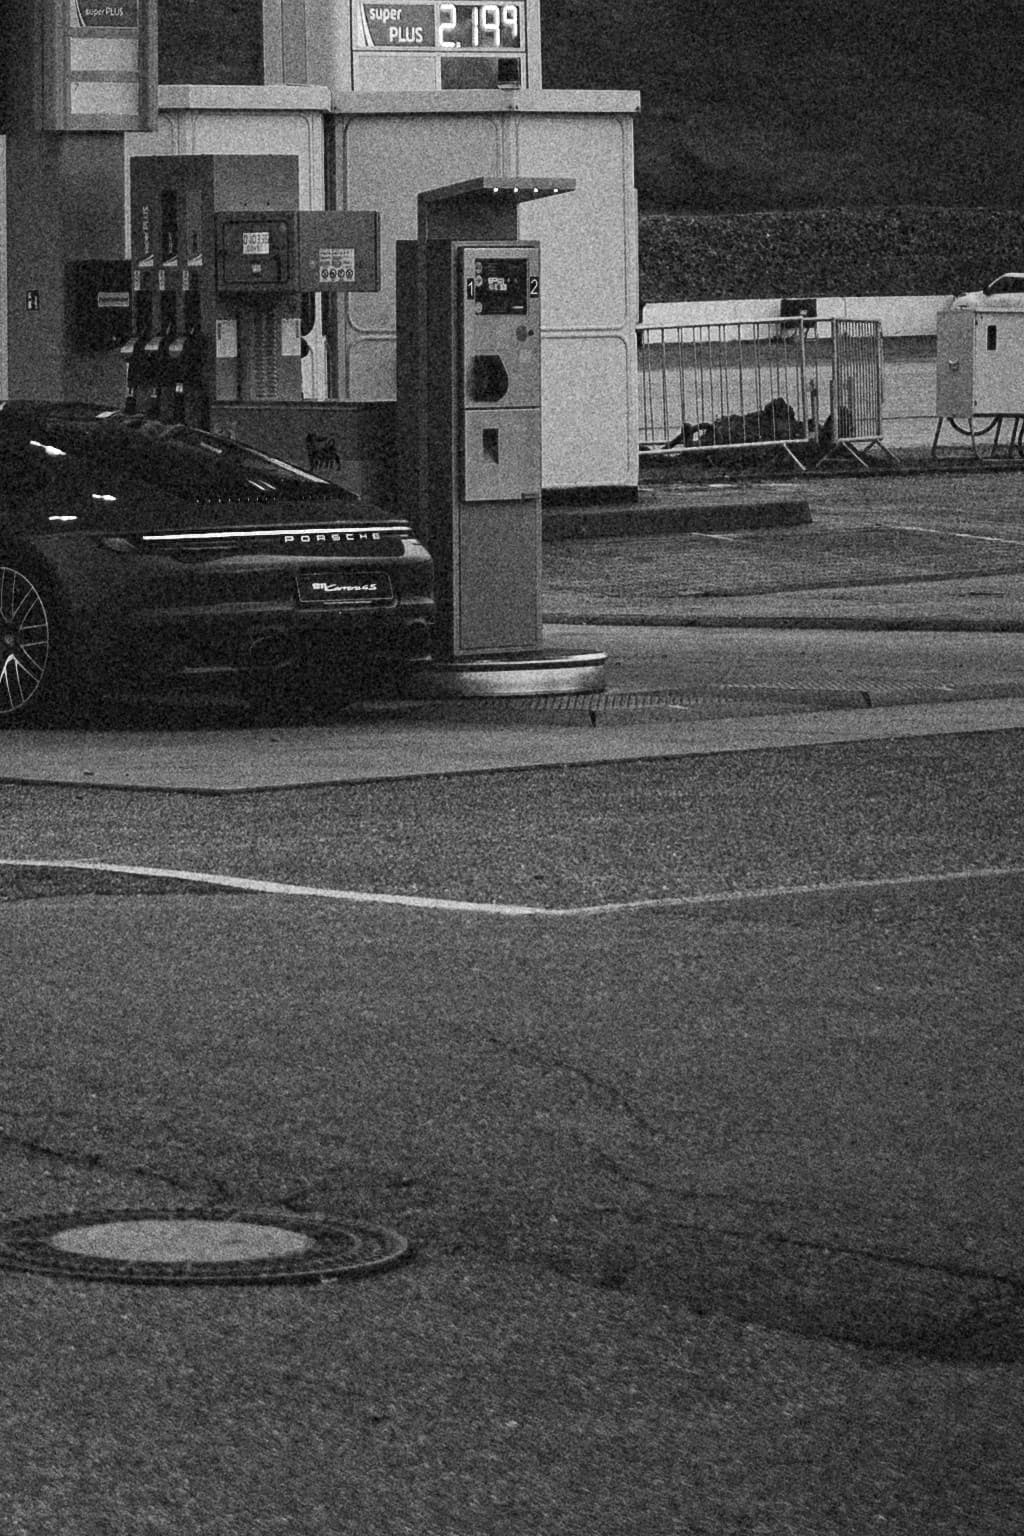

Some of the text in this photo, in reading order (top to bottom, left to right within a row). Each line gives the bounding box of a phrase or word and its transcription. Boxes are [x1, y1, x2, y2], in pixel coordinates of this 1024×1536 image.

[369, 6, 402, 24] super
[438, 3, 518, 48] 2.199
[389, 26, 423, 43] PLUS
[467, 280, 473, 297] 1
[530, 278, 539, 295] 2
[284, 532, 381, 543] PORSCHE
